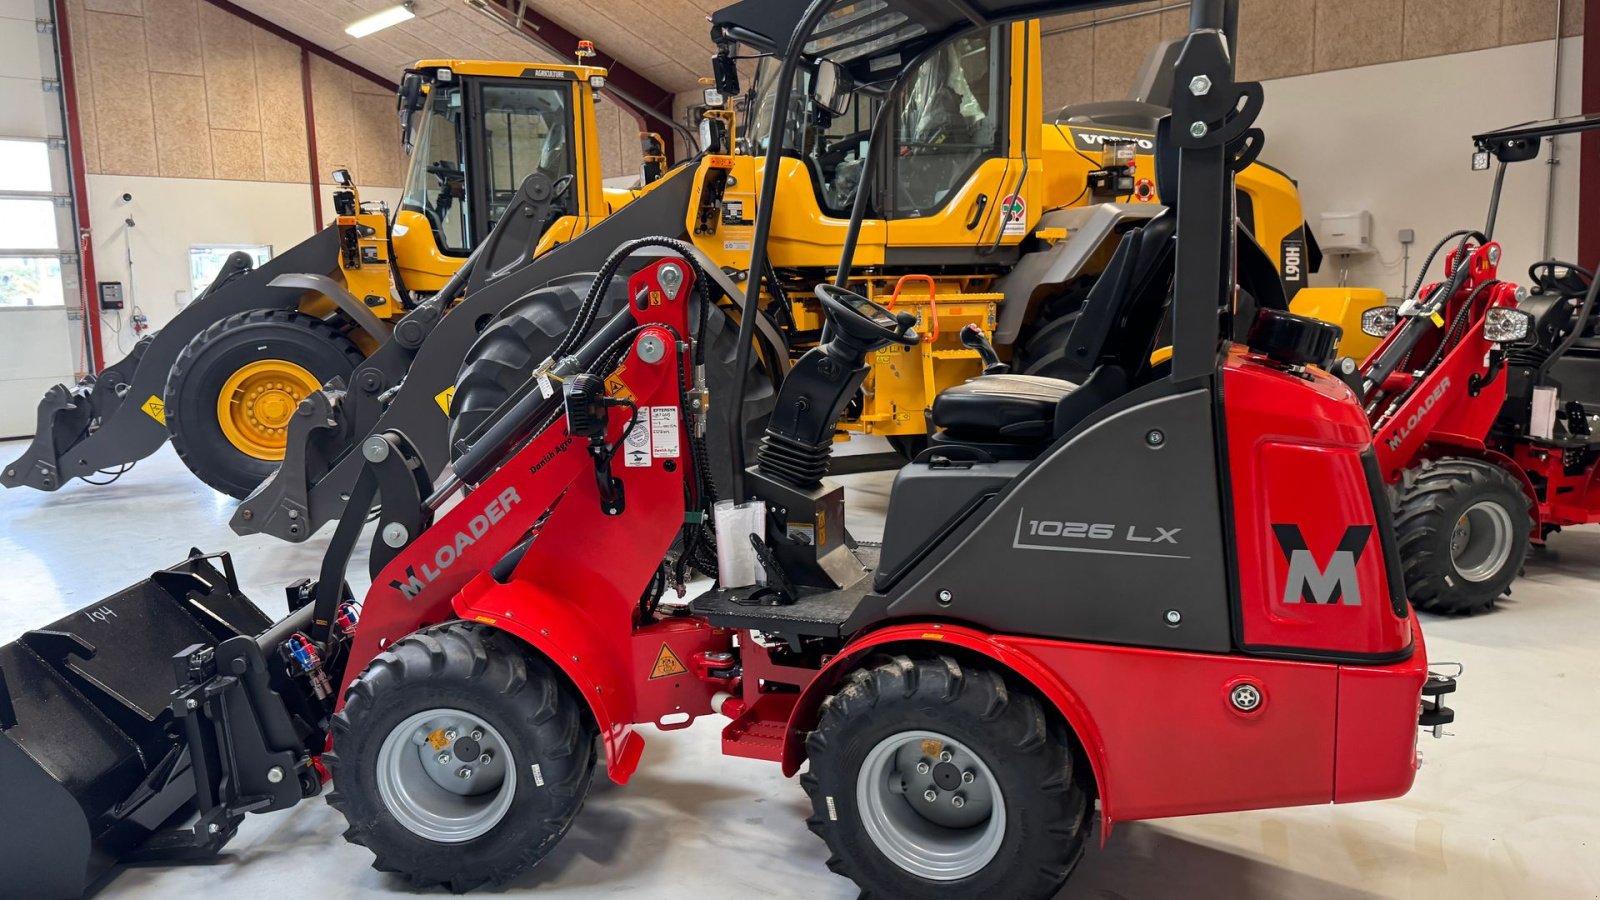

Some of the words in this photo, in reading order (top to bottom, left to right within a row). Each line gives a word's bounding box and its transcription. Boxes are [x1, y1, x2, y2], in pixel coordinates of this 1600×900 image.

[1285, 247, 1300, 281] L90H
[1400, 376, 1451, 439] LOADER
[530, 450, 555, 474] Danish
[554, 437, 573, 454] Agro
[421, 486, 522, 583] LOADER
[1029, 520, 1116, 540] 1026
[1126, 525, 1183, 544] LX
